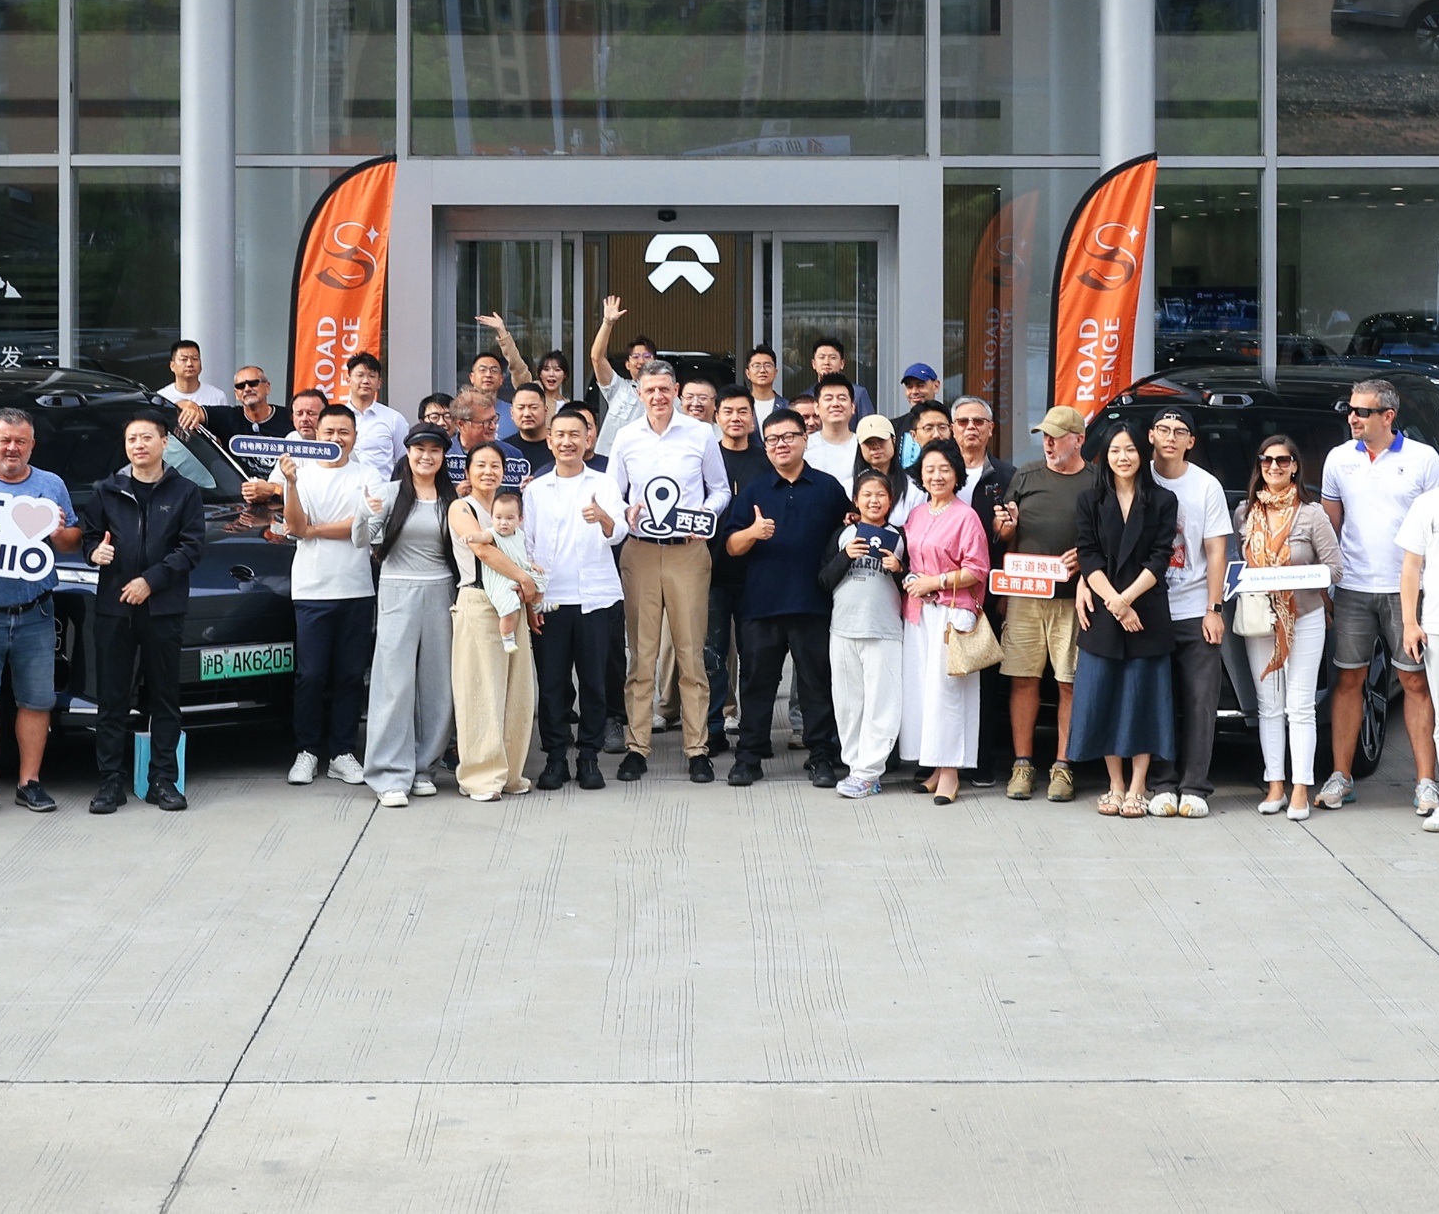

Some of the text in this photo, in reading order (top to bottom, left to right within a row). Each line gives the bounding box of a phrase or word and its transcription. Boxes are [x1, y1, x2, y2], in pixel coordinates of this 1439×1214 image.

[314, 316, 338, 400] ROAD
[1076, 318, 1100, 403] ROAD
[676, 511, 711, 534] 西安
[1011, 560, 1061, 575] 乐道换电
[996, 576, 1048, 592] 生而成熟
[232, 647, 292, 673] AK6205
